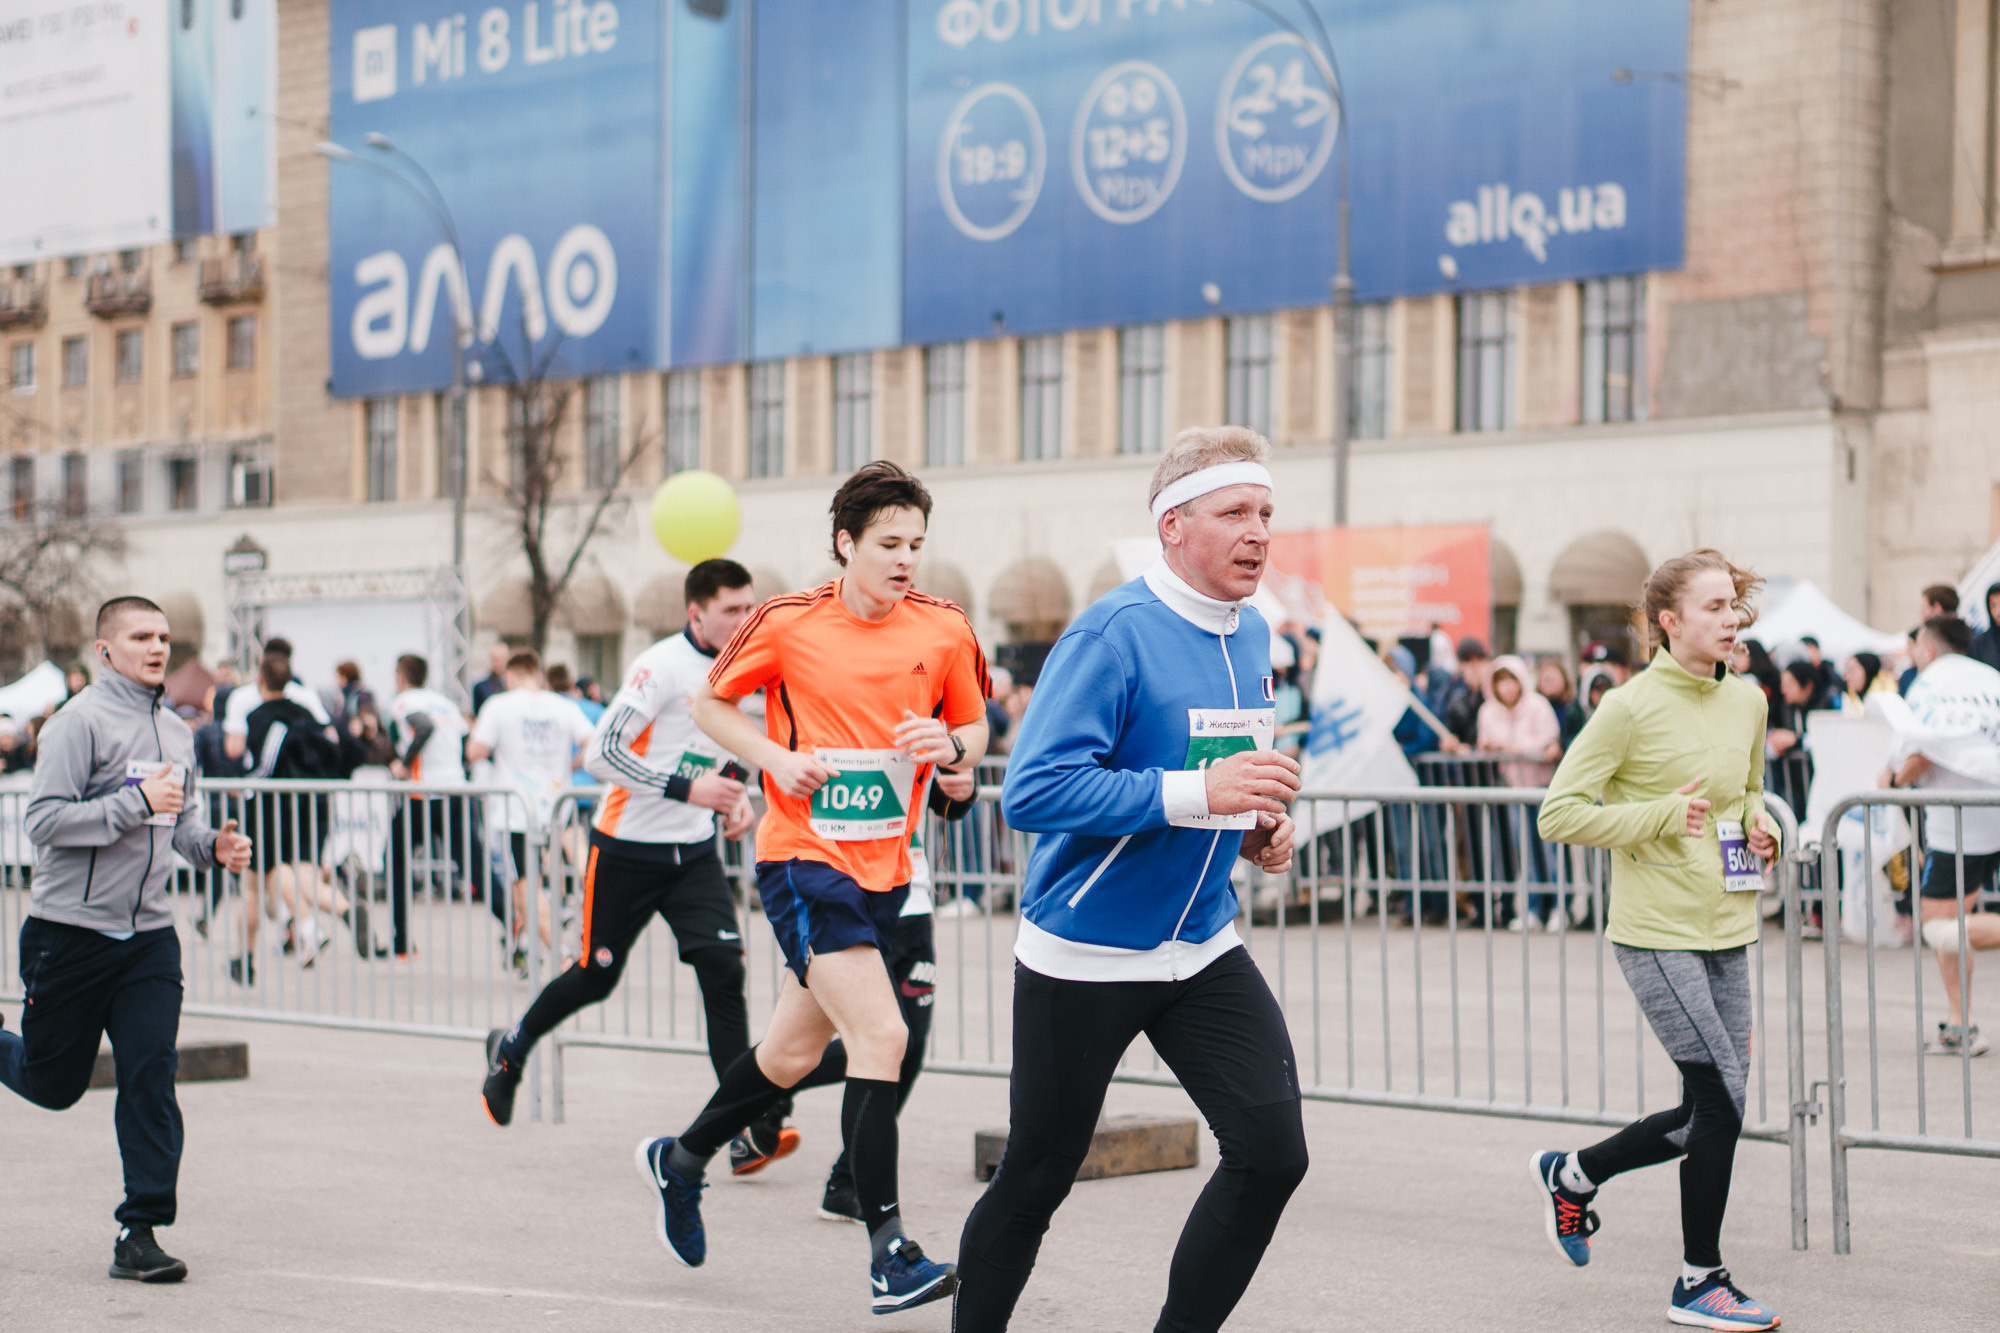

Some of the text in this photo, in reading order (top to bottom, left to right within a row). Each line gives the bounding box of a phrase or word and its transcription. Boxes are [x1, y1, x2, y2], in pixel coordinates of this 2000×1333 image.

[413, 0, 619, 86] Mi 8 Lite
[1209, 720, 1250, 730] Жилстрой-1
[821, 784, 884, 811] 1049
[818, 824, 828, 832] 10
[1727, 847, 1759, 872] 508
